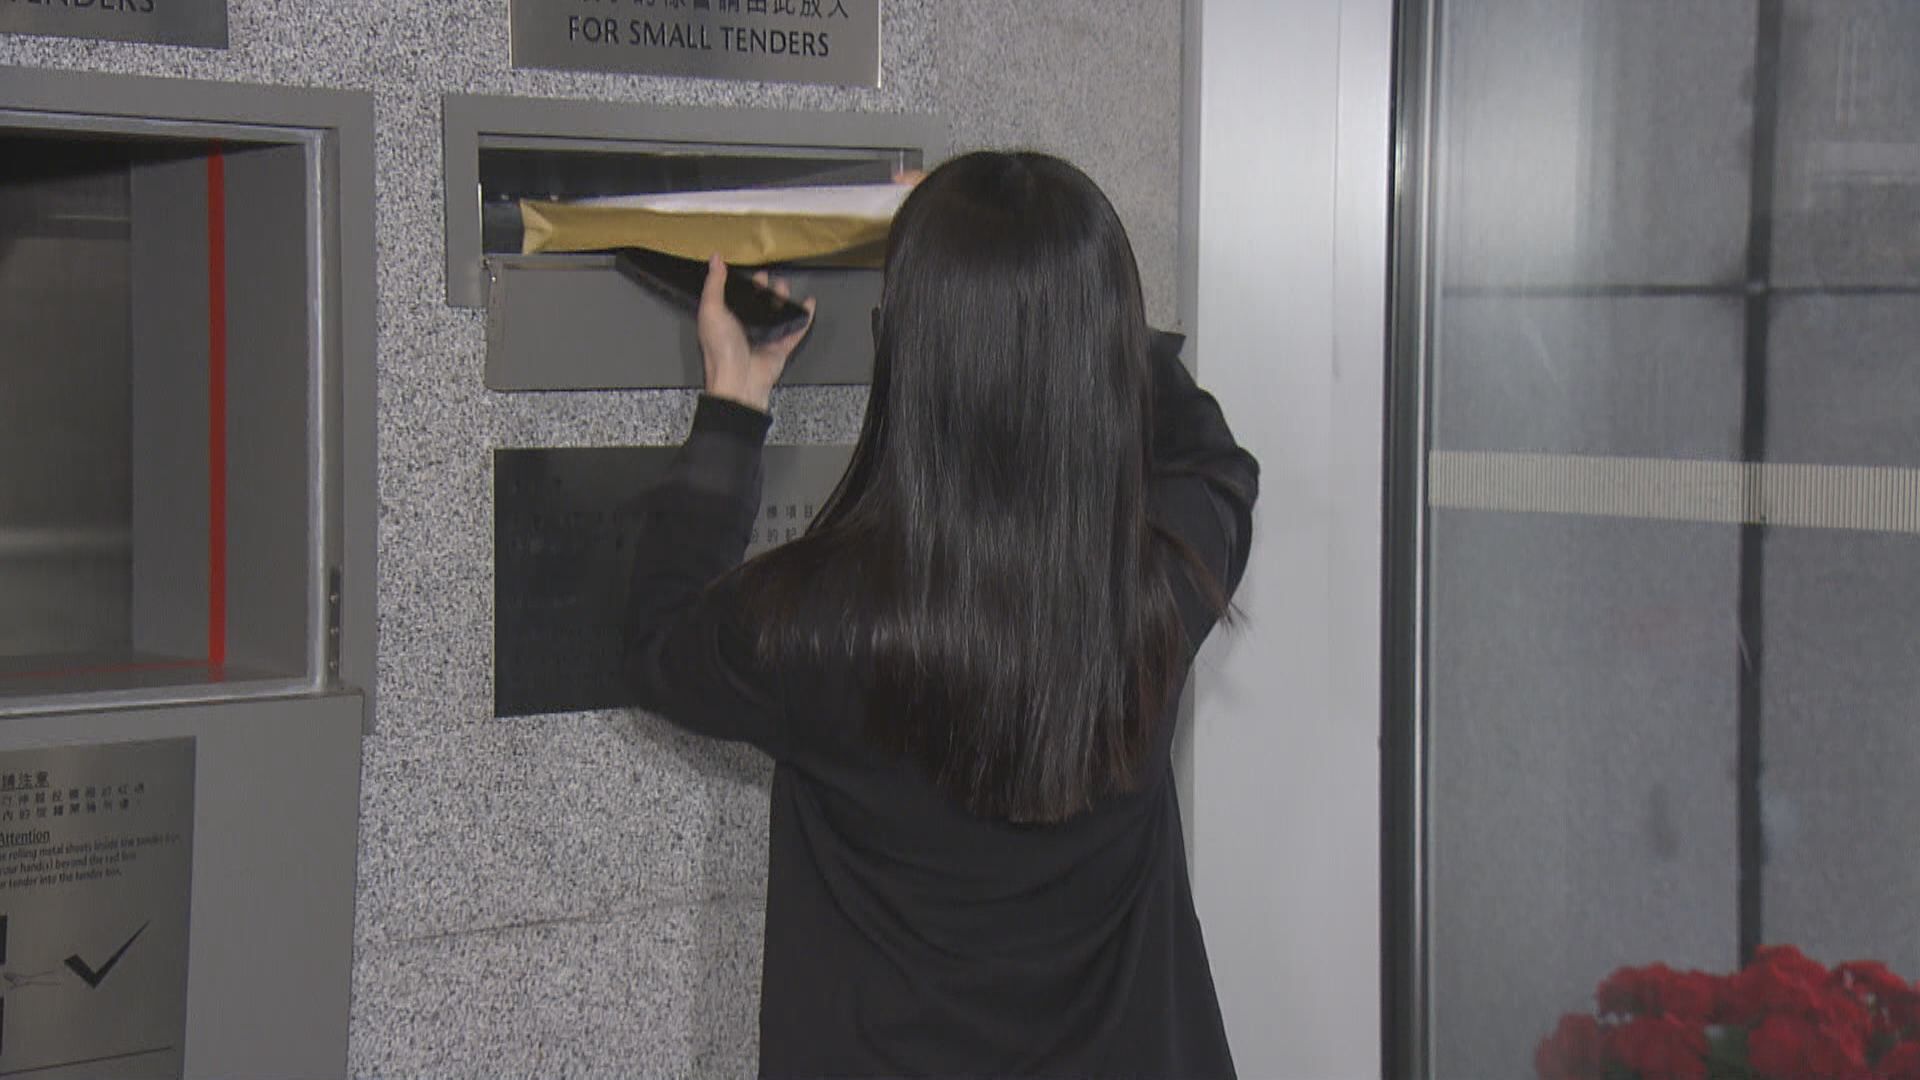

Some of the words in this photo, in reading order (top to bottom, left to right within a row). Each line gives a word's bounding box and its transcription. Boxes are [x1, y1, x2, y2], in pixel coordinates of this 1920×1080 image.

[568, 15, 620, 44] FOR
[629, 19, 712, 50] SMALL
[719, 26, 829, 57] TENDERS
